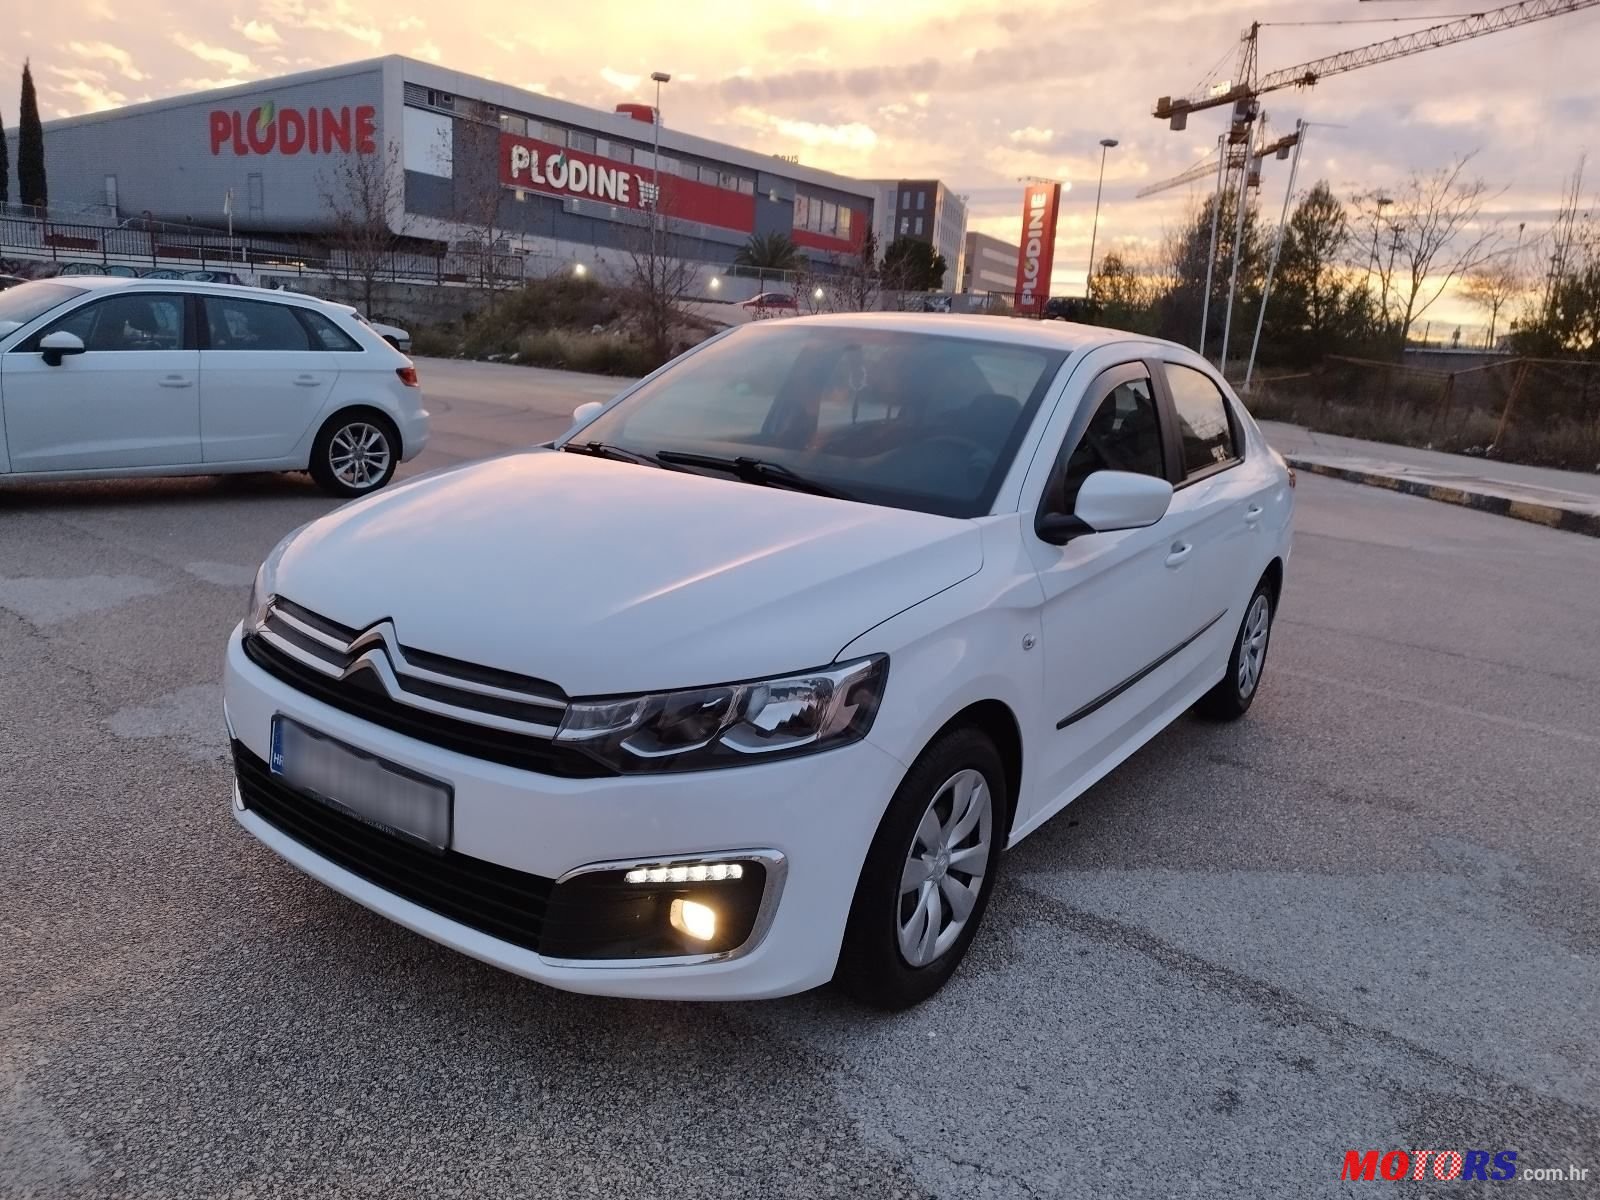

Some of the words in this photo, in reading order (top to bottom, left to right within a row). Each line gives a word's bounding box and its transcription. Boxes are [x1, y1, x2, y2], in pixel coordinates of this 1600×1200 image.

[210, 105, 376, 156] PLODINE
[511, 144, 630, 203] PLODINE
[1021, 192, 1047, 306] PLODINE
